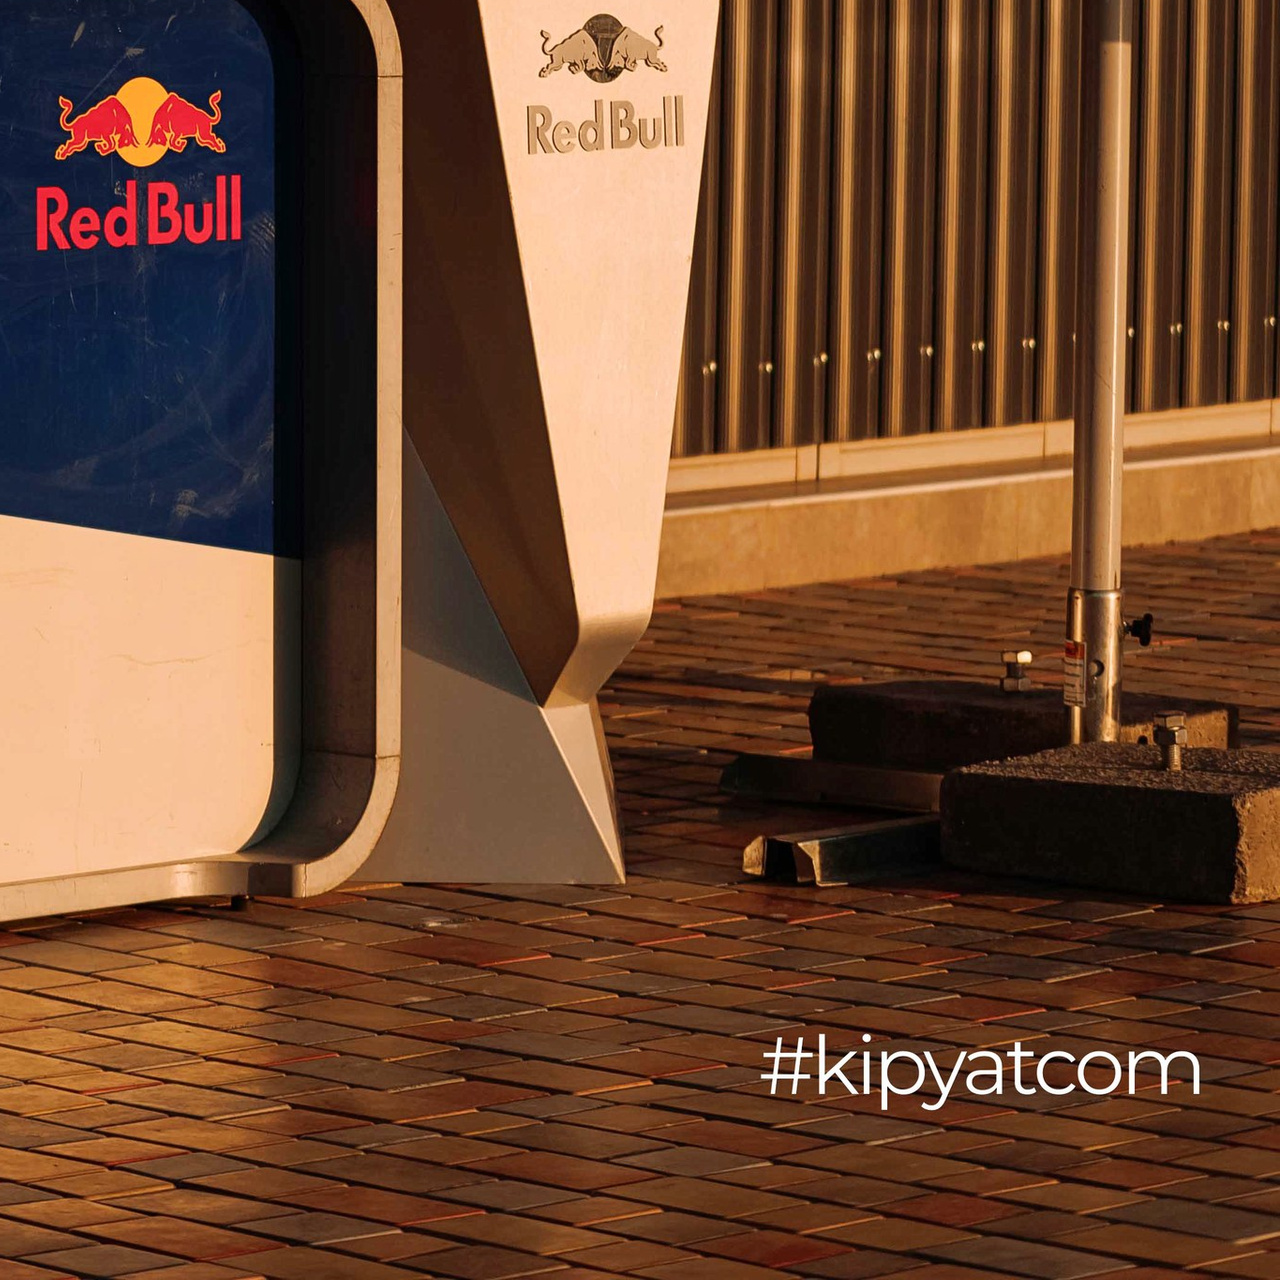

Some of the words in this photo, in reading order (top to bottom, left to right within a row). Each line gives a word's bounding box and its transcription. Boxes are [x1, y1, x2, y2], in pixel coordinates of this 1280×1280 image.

[527, 99, 605, 155] Red
[610, 95, 685, 150] Bull
[36, 180, 138, 251] Red
[147, 174, 242, 245] Bull
